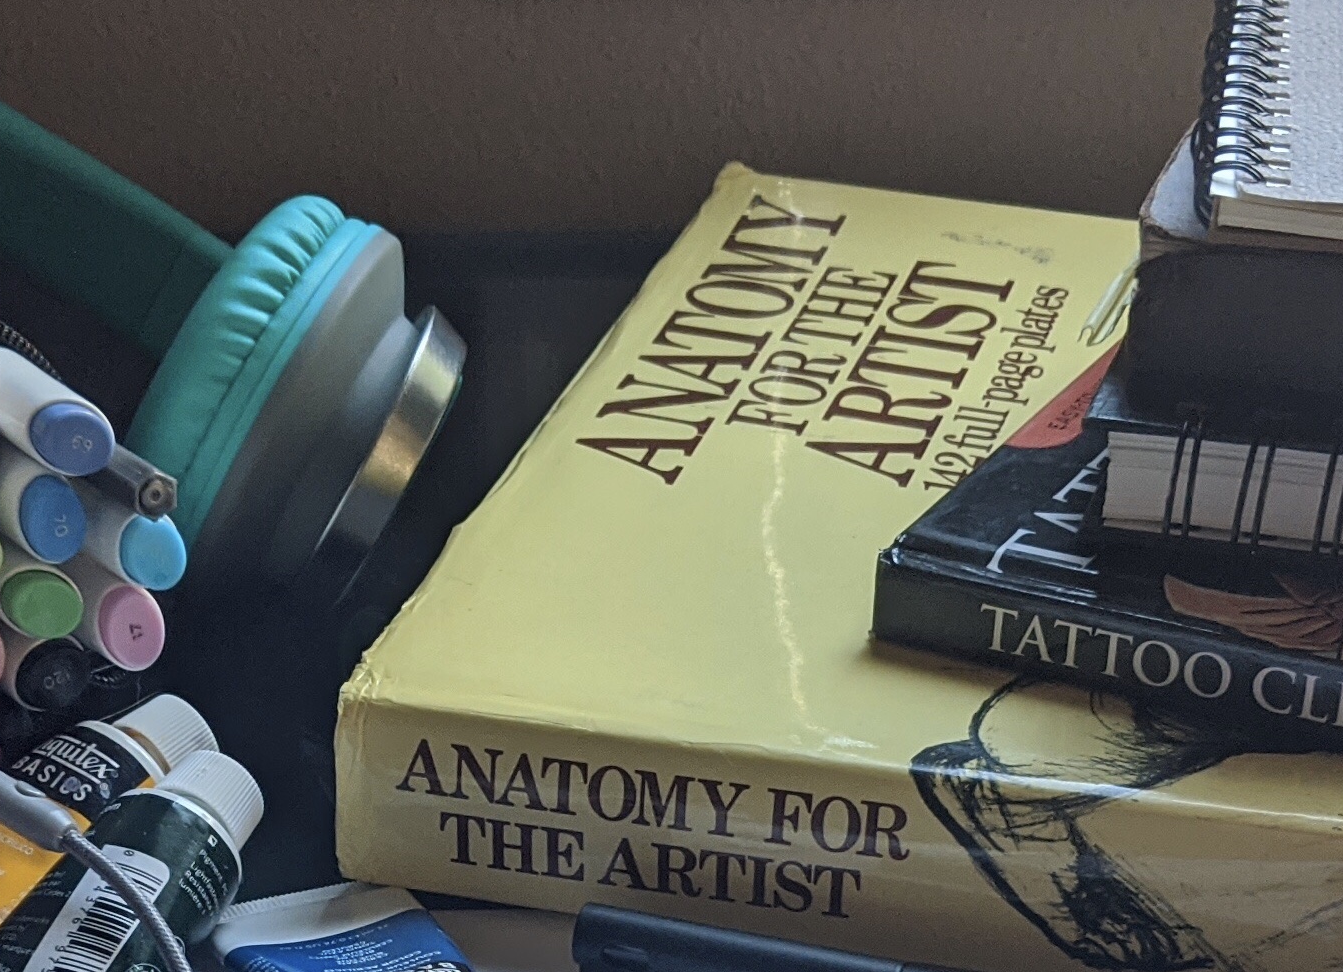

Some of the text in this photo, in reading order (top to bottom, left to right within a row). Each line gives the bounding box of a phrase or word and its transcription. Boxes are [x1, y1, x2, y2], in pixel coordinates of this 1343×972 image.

[576, 194, 847, 485] ANATOMY
[725, 267, 898, 436] FOR THE
[805, 260, 1014, 488] ARTIST
[945, 352, 1043, 460] full-page
[1000, 285, 1069, 354] plates
[980, 601, 1232, 700] TATTOO
[12, 756, 91, 802] BASICS
[396, 737, 910, 861] ANATOMY FOR
[440, 810, 861, 918] THE ARTIST
